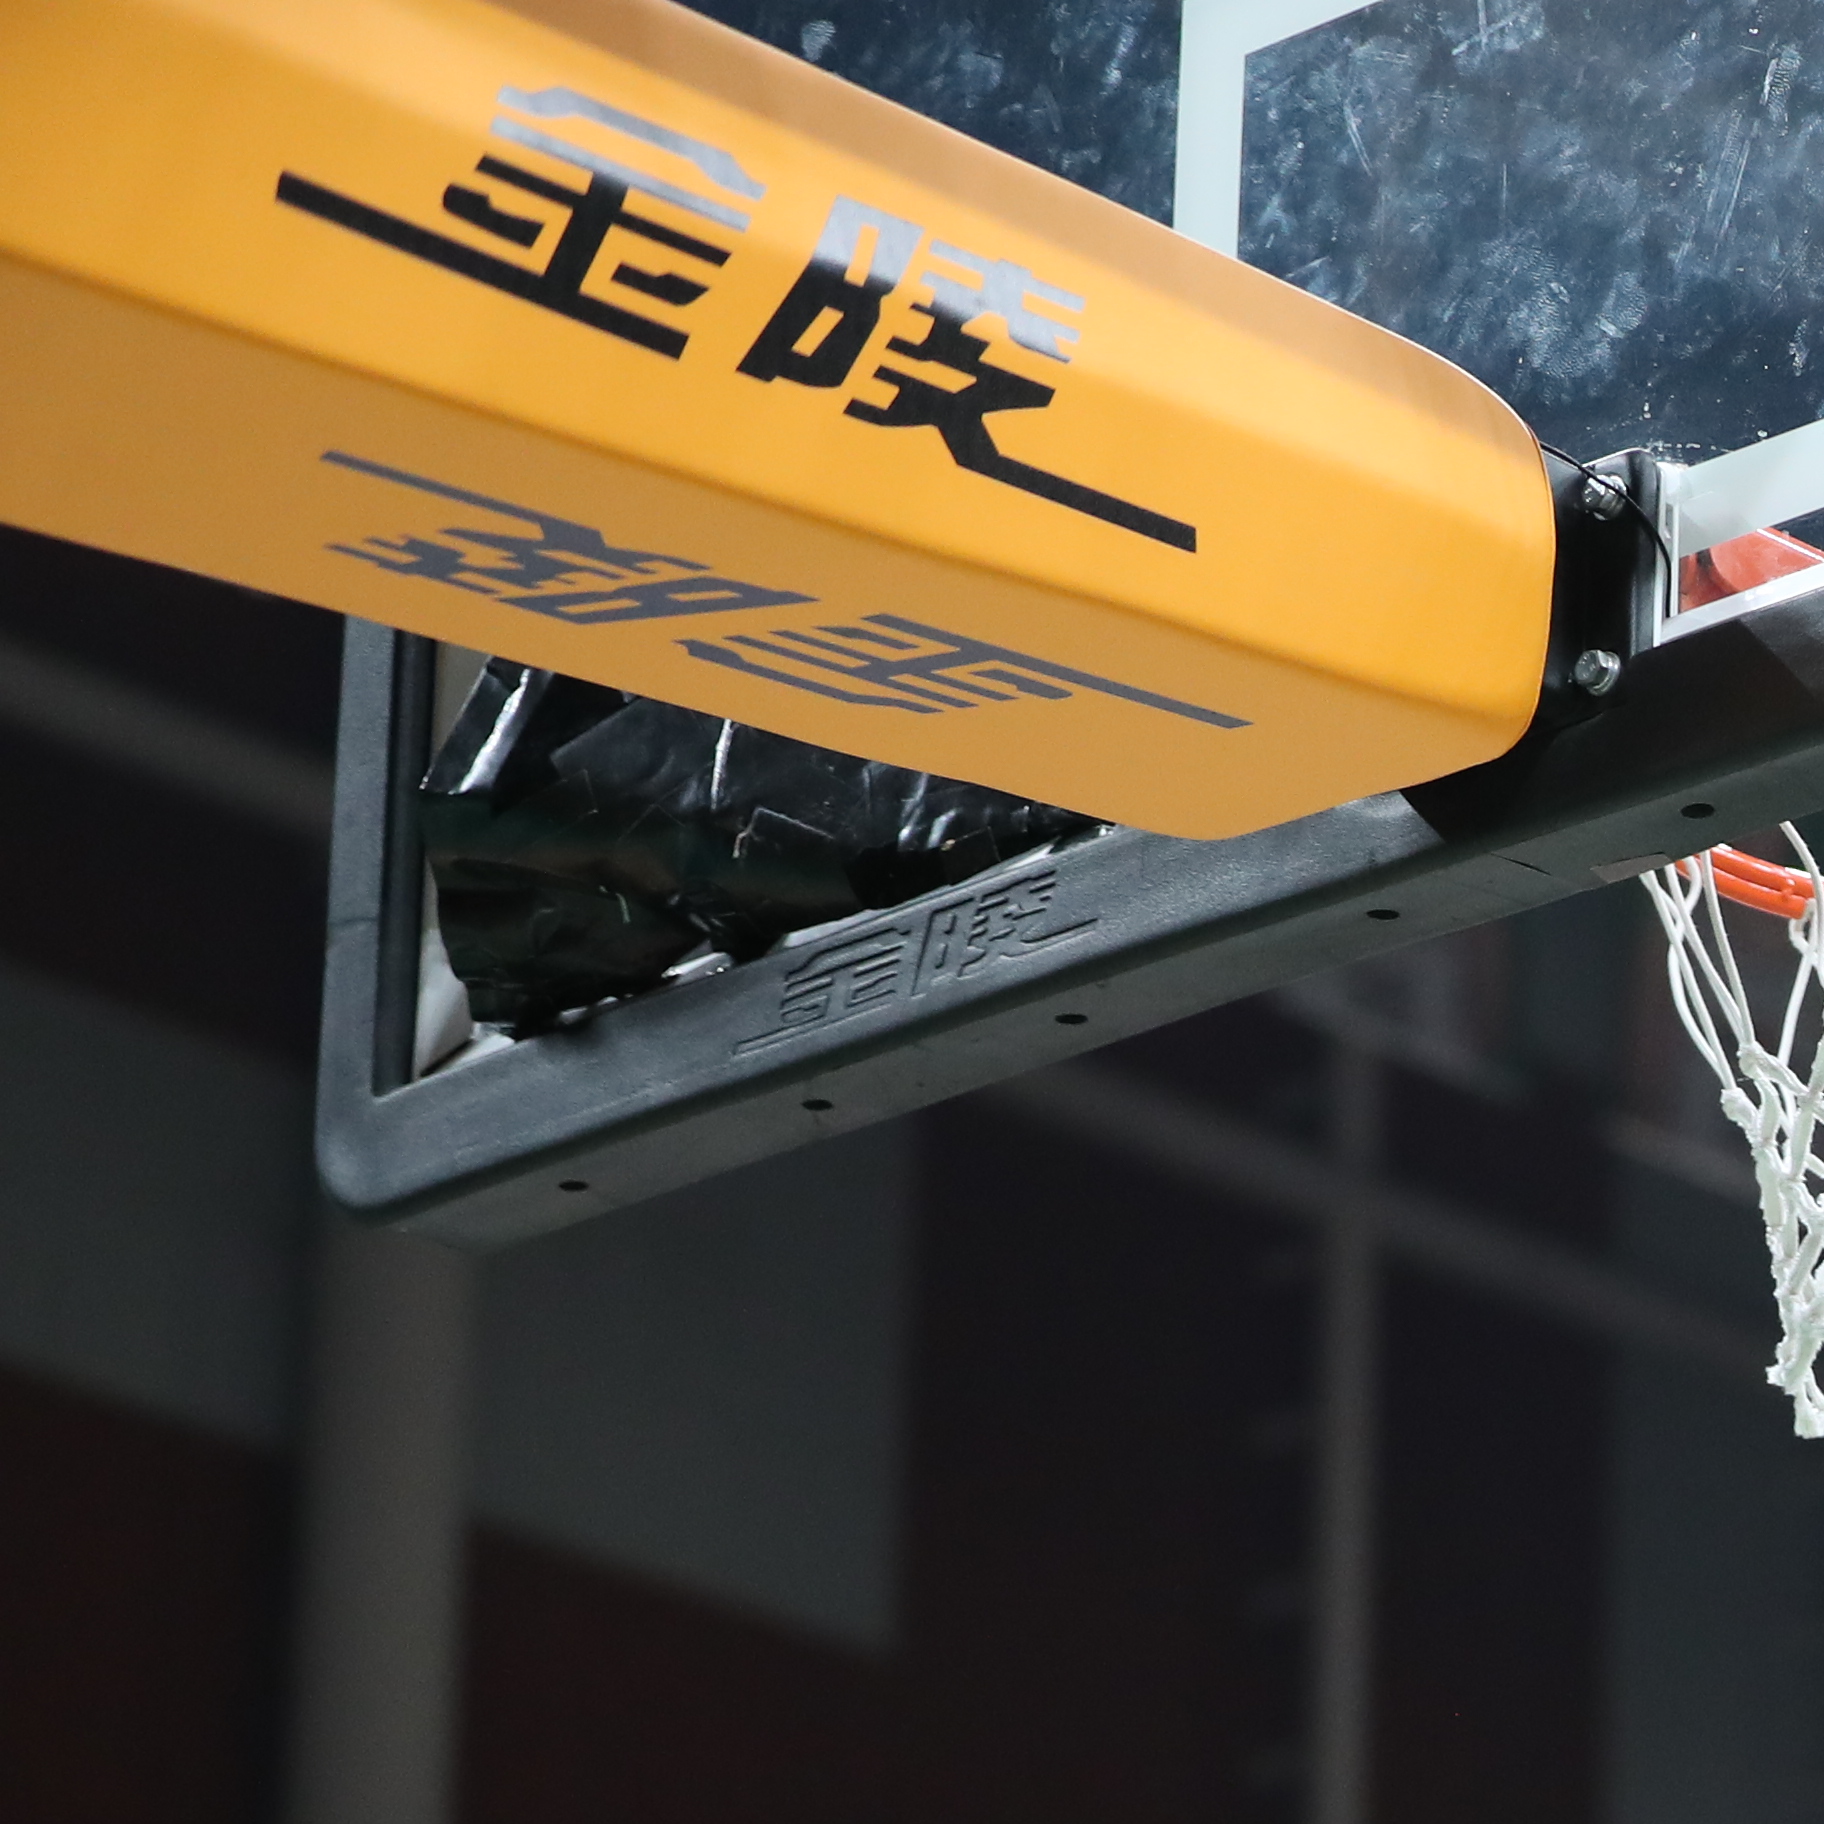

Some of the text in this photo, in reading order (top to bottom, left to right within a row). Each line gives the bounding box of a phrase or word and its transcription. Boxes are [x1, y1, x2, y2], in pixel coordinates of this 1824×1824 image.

[275, 84, 1196, 553] 金陵
[320, 448, 1254, 728] 金陵
[731, 868, 1099, 1056] 金陵
